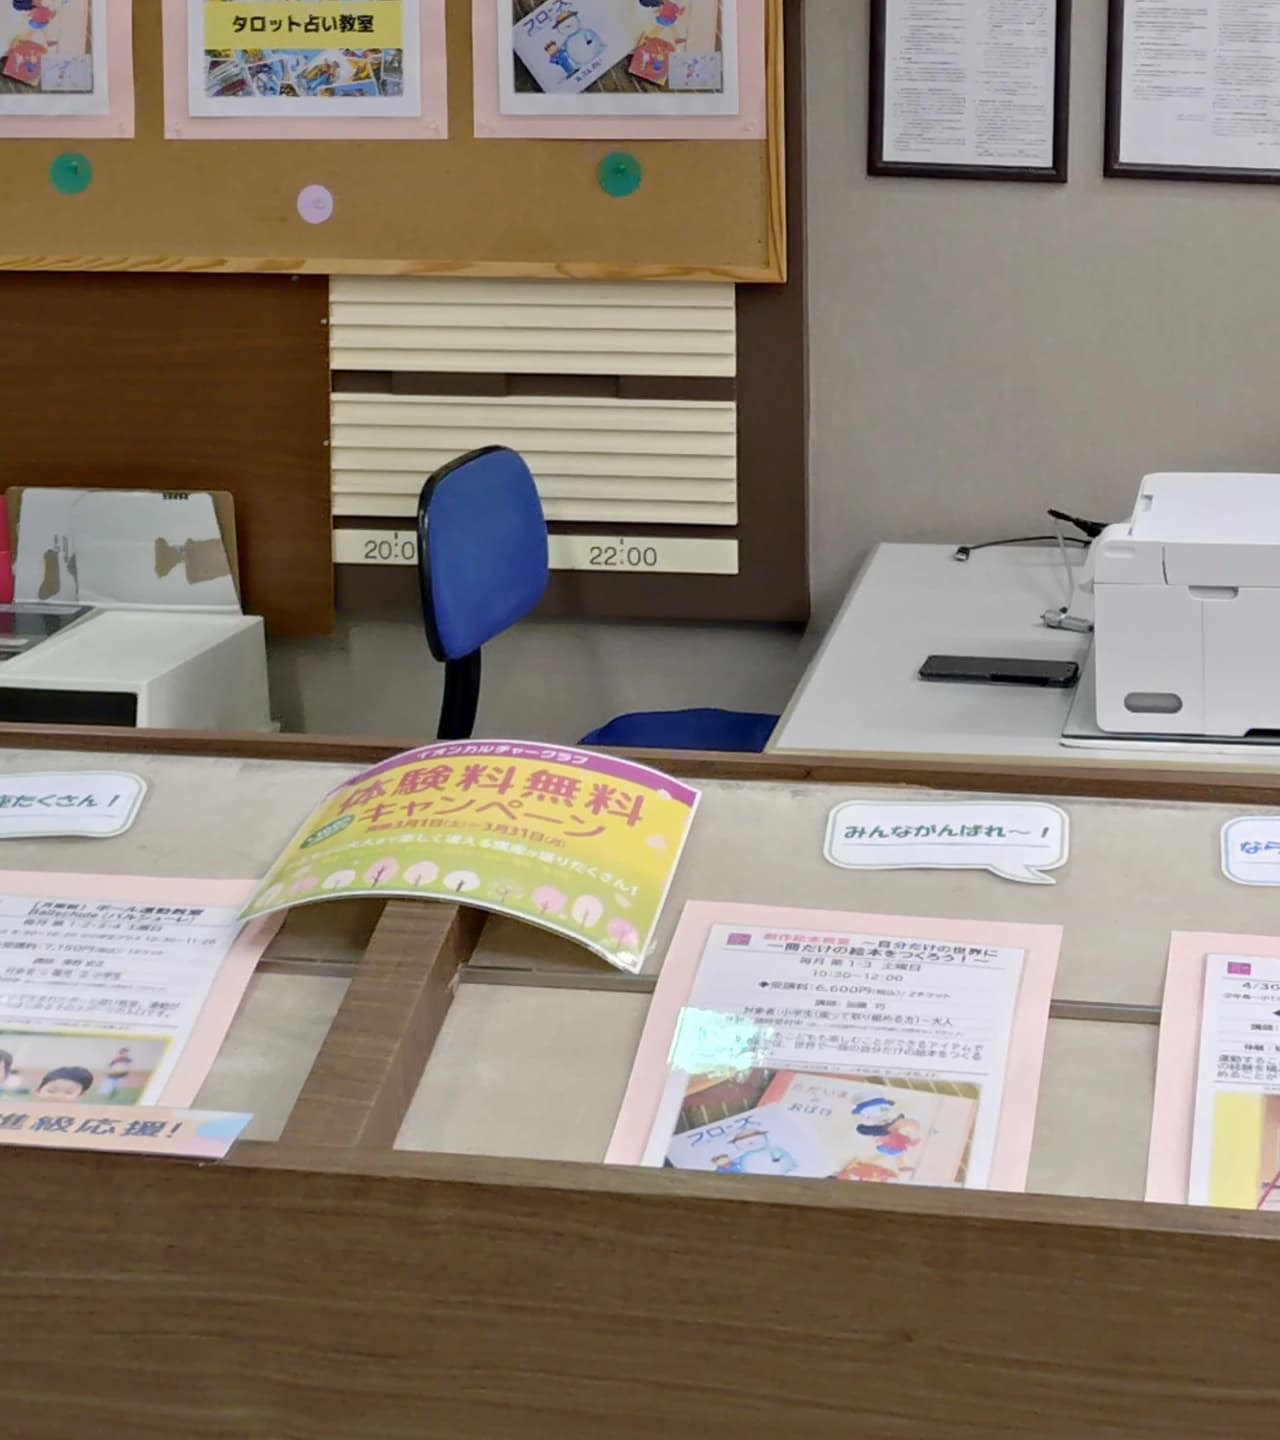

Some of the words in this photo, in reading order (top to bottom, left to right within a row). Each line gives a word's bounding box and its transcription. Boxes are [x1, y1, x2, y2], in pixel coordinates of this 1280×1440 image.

[231, 14, 375, 34] タロット占い教室
[363, 539, 415, 562] 20:0
[588, 545, 659, 568] 22:00
[415, 743, 591, 765] イオンカルチャークラブ
[337, 763, 646, 828] 体験料無料
[358, 794, 607, 839] キャンペーン
[843, 822, 1053, 841] みんながんばれ～！
